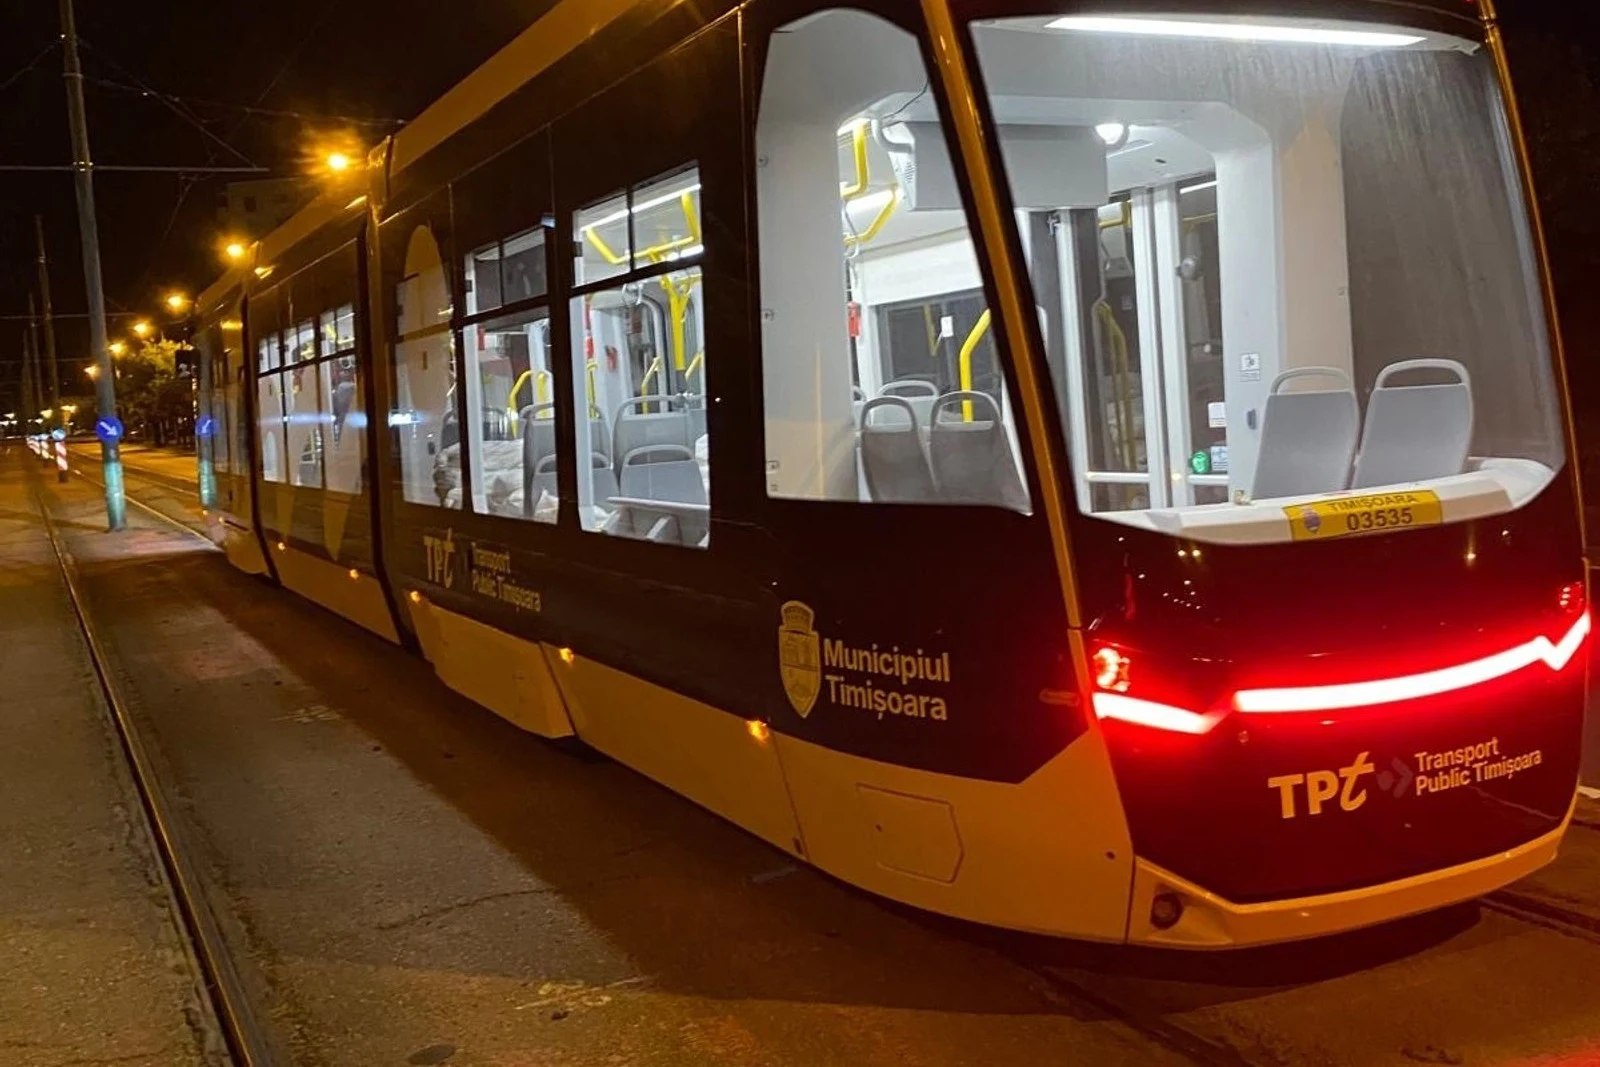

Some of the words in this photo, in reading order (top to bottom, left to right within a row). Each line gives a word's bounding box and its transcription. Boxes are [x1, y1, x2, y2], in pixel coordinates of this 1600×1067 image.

[1346, 507, 1413, 531] 03535
[823, 638, 950, 685] Municipiul
[825, 674, 948, 720] Timișoara
[1414, 737, 1499, 773] Transport
[1416, 766, 1470, 795] Public
[1475, 750, 1542, 780] Timișoara
[1268, 751, 1375, 819] TPt
